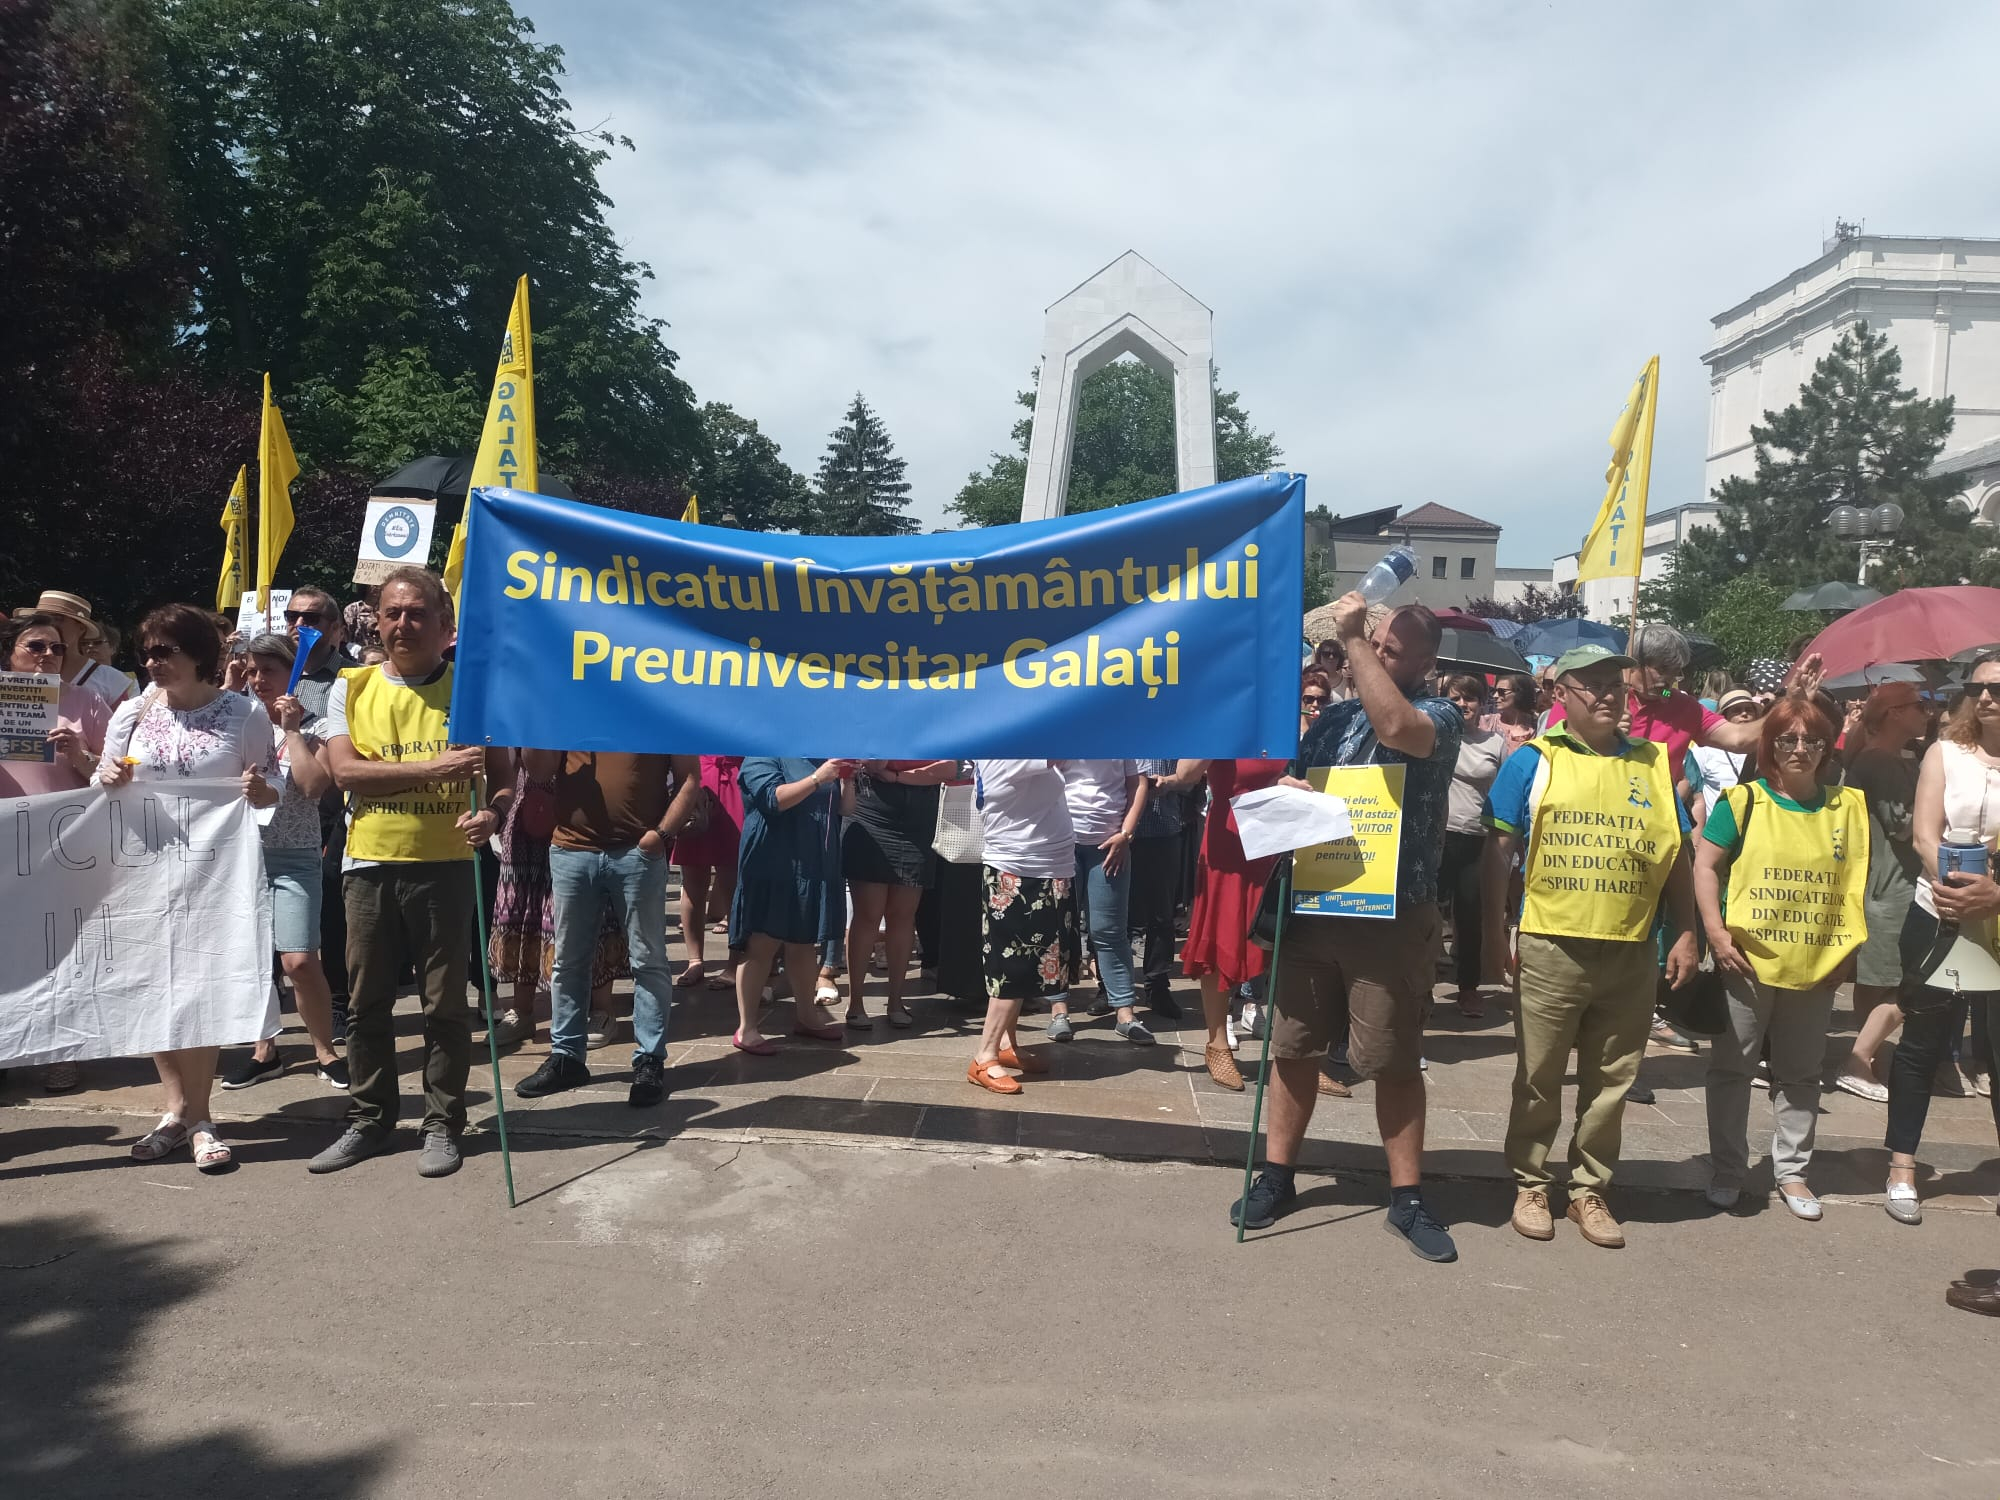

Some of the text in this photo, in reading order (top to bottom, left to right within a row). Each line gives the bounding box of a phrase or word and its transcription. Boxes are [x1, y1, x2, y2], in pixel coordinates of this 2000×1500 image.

[503, 543, 1259, 625] Sindicatul Învățământului
[572, 631, 1181, 699] Preuniversitar Galați
[16, 711, 46, 719] TEAMĂ
[1352, 795, 1379, 806] elevi,
[1365, 809, 1397, 818] astăzi
[1357, 823, 1392, 832] VIITOR
[1553, 811, 1646, 832] FEDERAȚIA
[1541, 832, 1656, 855] SINDICATELOR
[1315, 851, 1376, 861] pentru VOI!
[1543, 854, 1567, 868] DIN
[1340, 899, 1366, 907] SUNTEM
[1749, 887, 1846, 907] SINDICATELOR
[1752, 907, 1779, 921] DIN
[1747, 927, 1800, 944] “SPIRU
